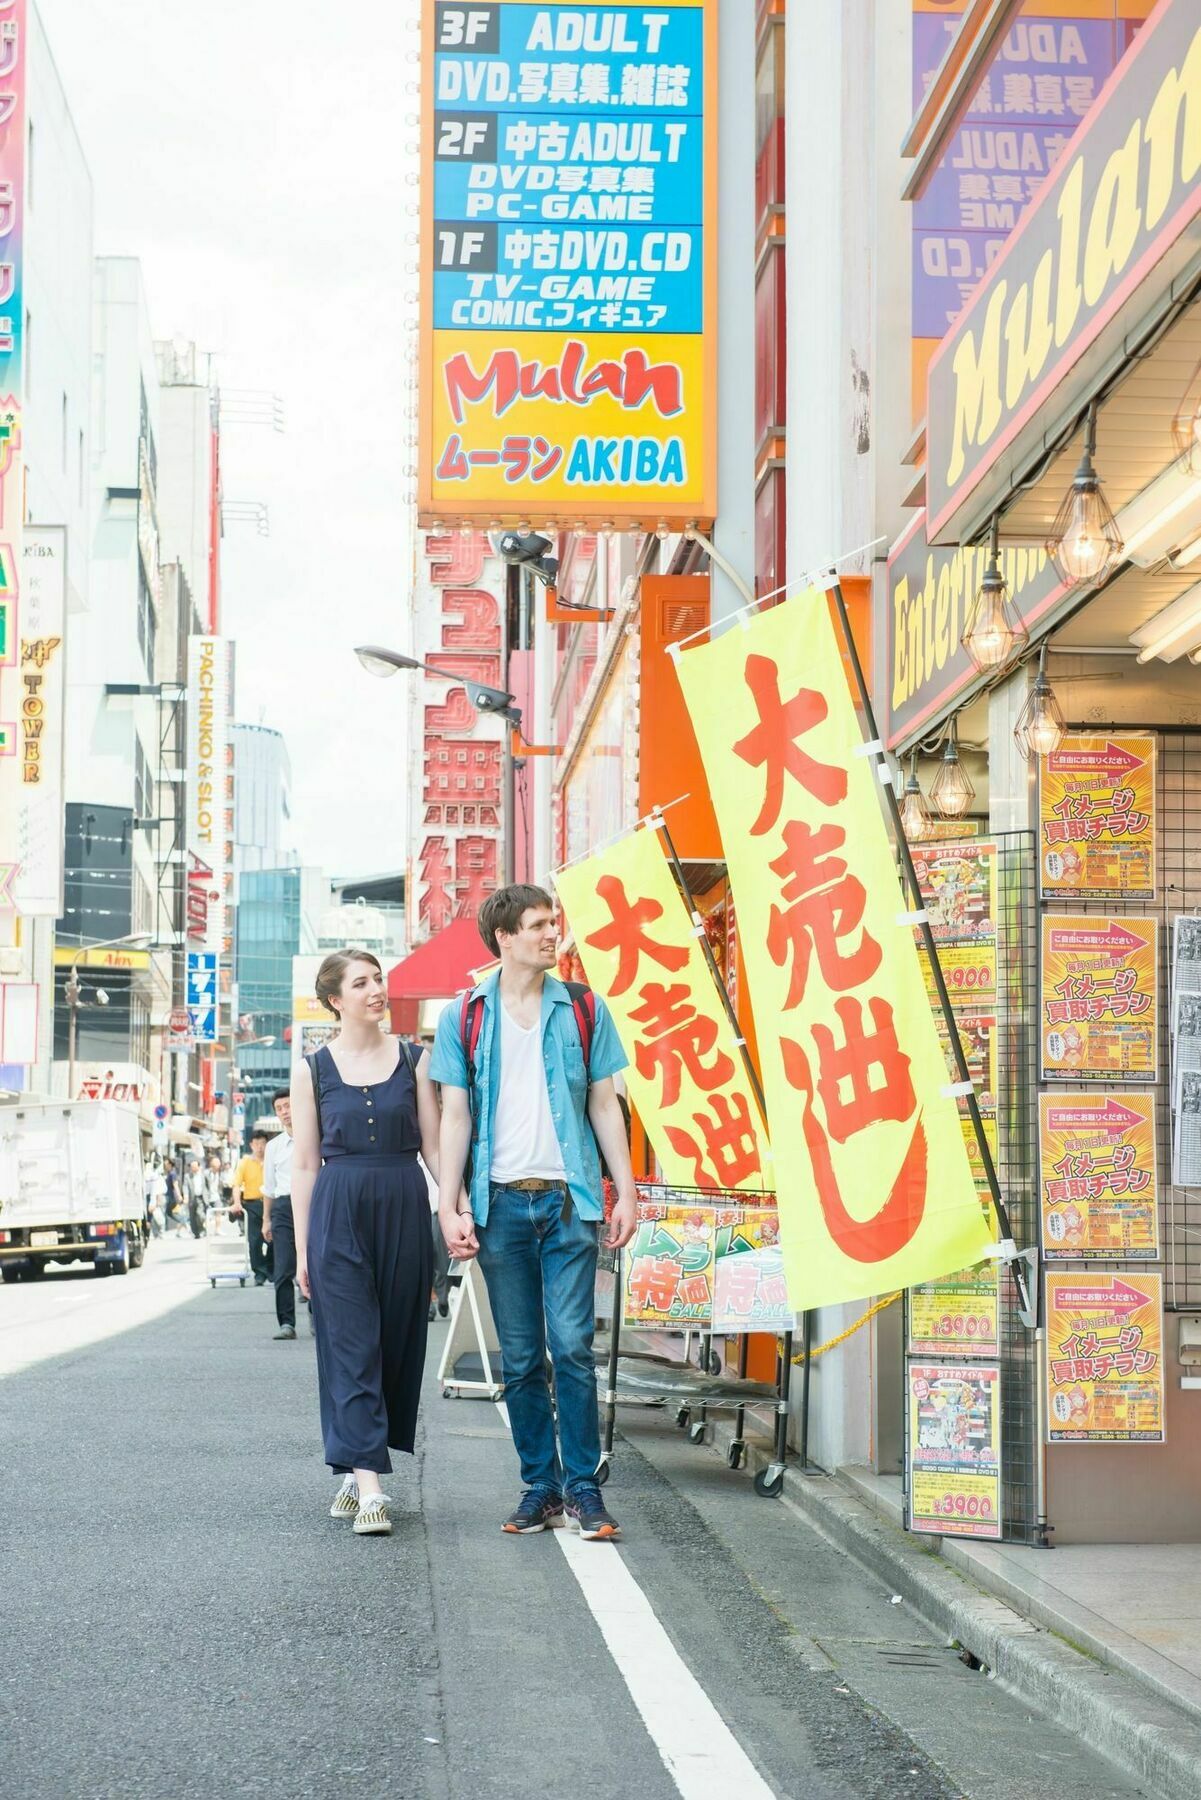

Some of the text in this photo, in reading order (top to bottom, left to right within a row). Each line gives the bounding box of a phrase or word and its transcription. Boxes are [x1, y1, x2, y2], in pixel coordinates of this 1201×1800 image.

[440, 11, 669, 53] 3F ADULT
[438, 60, 691, 106] DVD.写真集.雑誌
[437, 121, 687, 162] 2F 中古ADULT
[468, 164, 655, 193] DVD写真集
[466, 193, 654, 220] PC-GAME
[439, 229, 692, 272] 1F 中古DVD.CD
[467, 274, 655, 301] TV-GAME
[444, 339, 684, 424] Mulan
[436, 434, 684, 483] ムーラン AKIBA
[22, 674, 43, 782] TOWER
[197, 642, 214, 843] PACHINKO & SLOT
[1052, 788, 1135, 820] イメージ
[1044, 811, 1150, 845] 買取チラシ
[731, 654, 929, 1264] 大売出し
[1054, 968, 1137, 1000] イメージ
[1046, 991, 1152, 1025] 買取チラシ
[1053, 1145, 1136, 1177] イメージ
[1045, 1169, 1151, 1205] 買取チラシ
[629, 1255, 711, 1312] 特価
[1059, 1326, 1143, 1358] イメージ
[1052, 1349, 1158, 1385] 買取チラシ
